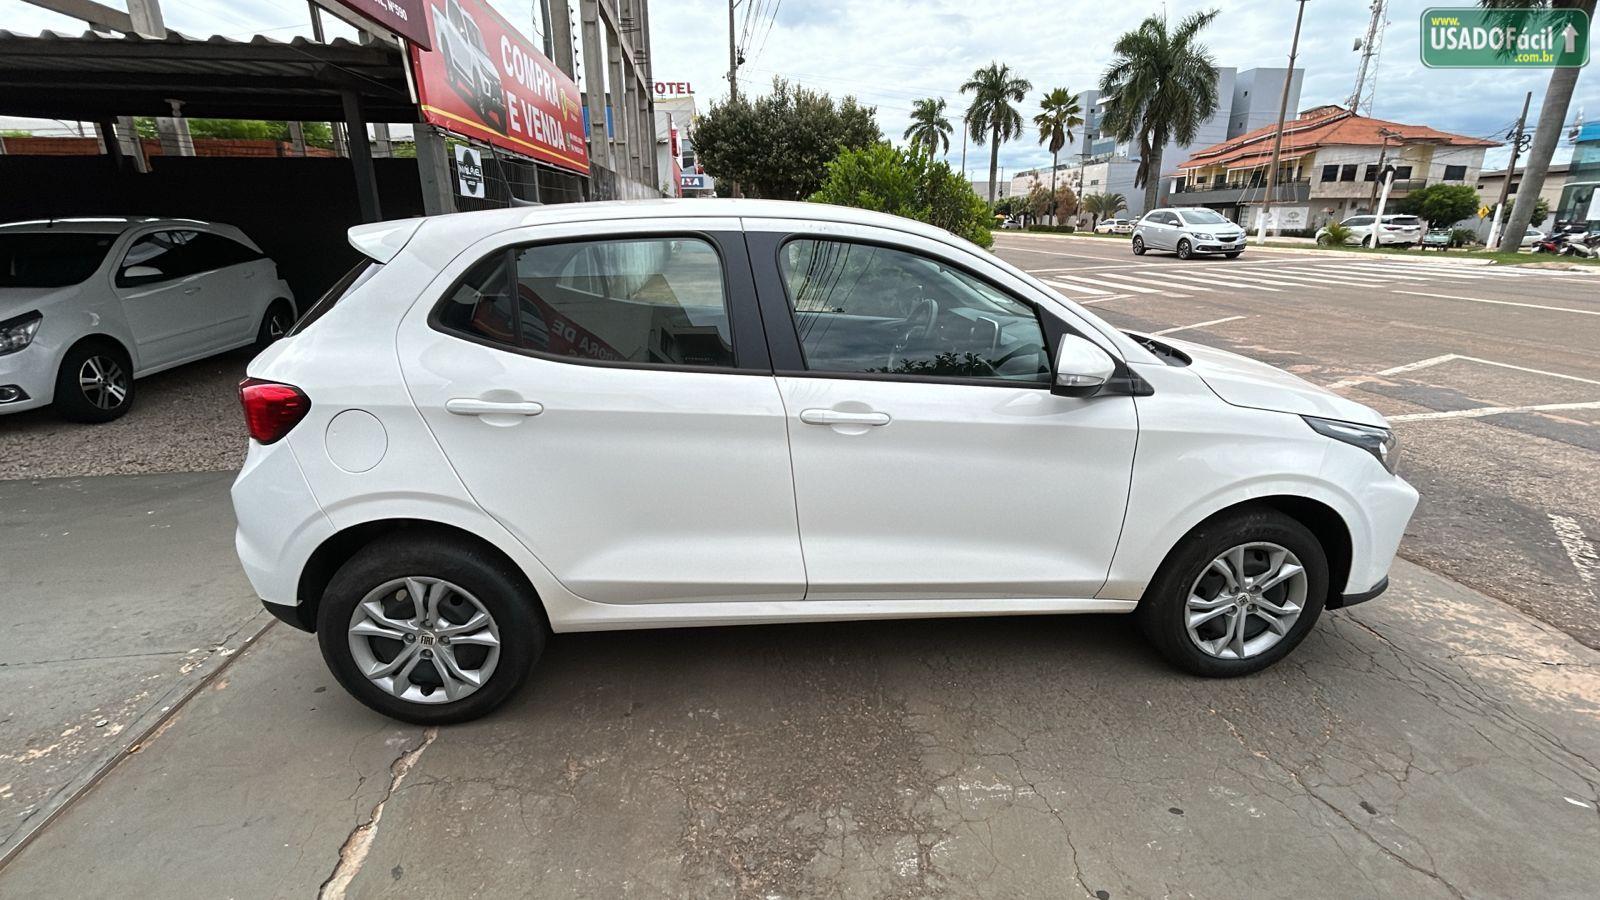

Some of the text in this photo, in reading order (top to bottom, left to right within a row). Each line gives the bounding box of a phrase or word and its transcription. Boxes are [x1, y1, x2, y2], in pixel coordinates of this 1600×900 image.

[500, 34, 560, 109] COMPRA
[654, 82, 695, 95] OTEL
[506, 90, 521, 133] E
[520, 98, 567, 152] VENDA
[681, 177, 700, 186] IXA
[420, 635, 434, 645] FIAT
